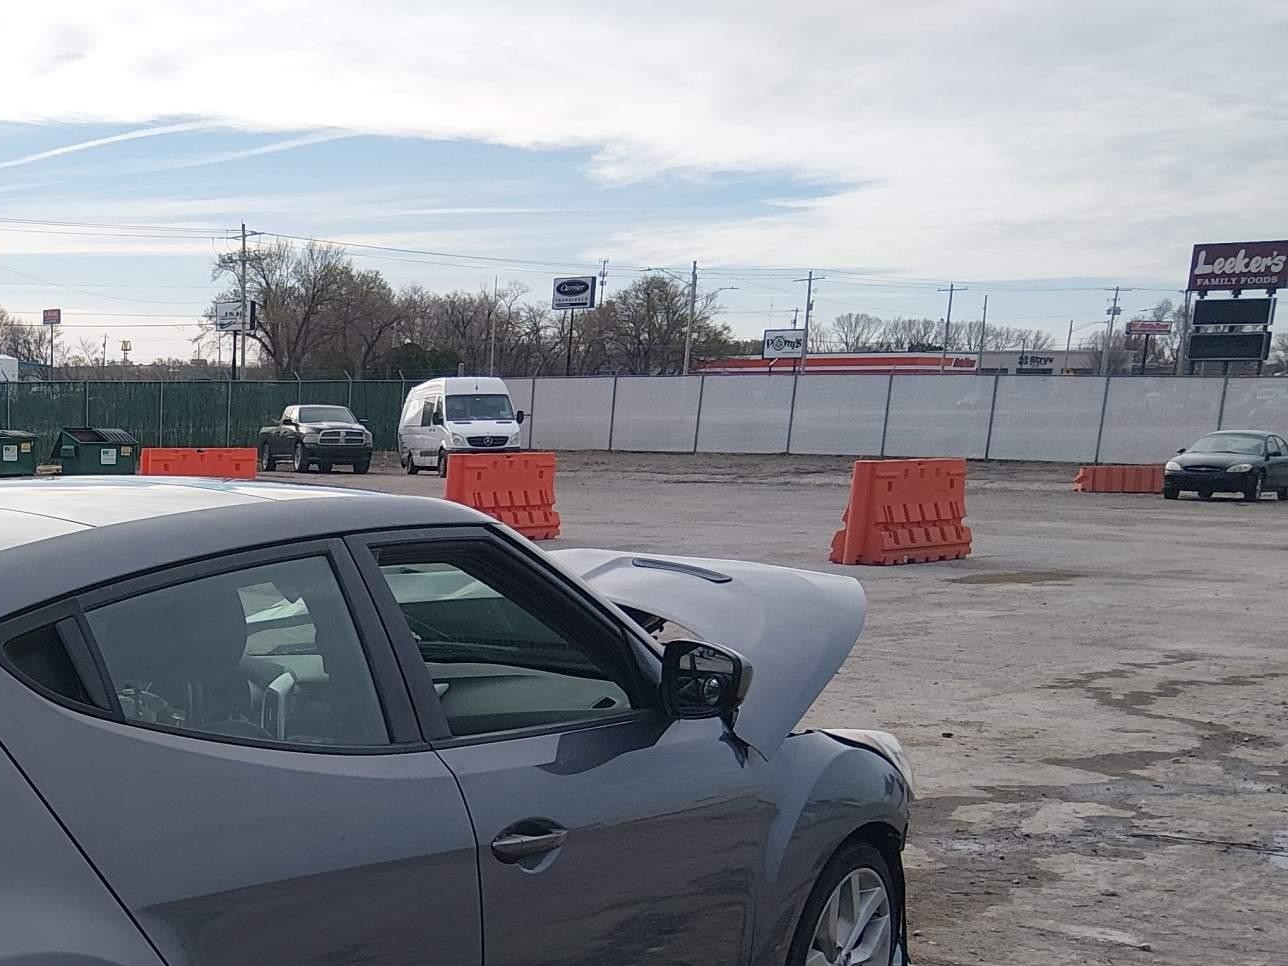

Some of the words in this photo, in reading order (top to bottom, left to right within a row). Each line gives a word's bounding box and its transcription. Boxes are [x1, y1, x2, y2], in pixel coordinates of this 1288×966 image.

[1194, 249, 1287, 275] Leeker's
[1240, 276, 1278, 284] FOODS
[560, 284, 585, 292] Carrier
